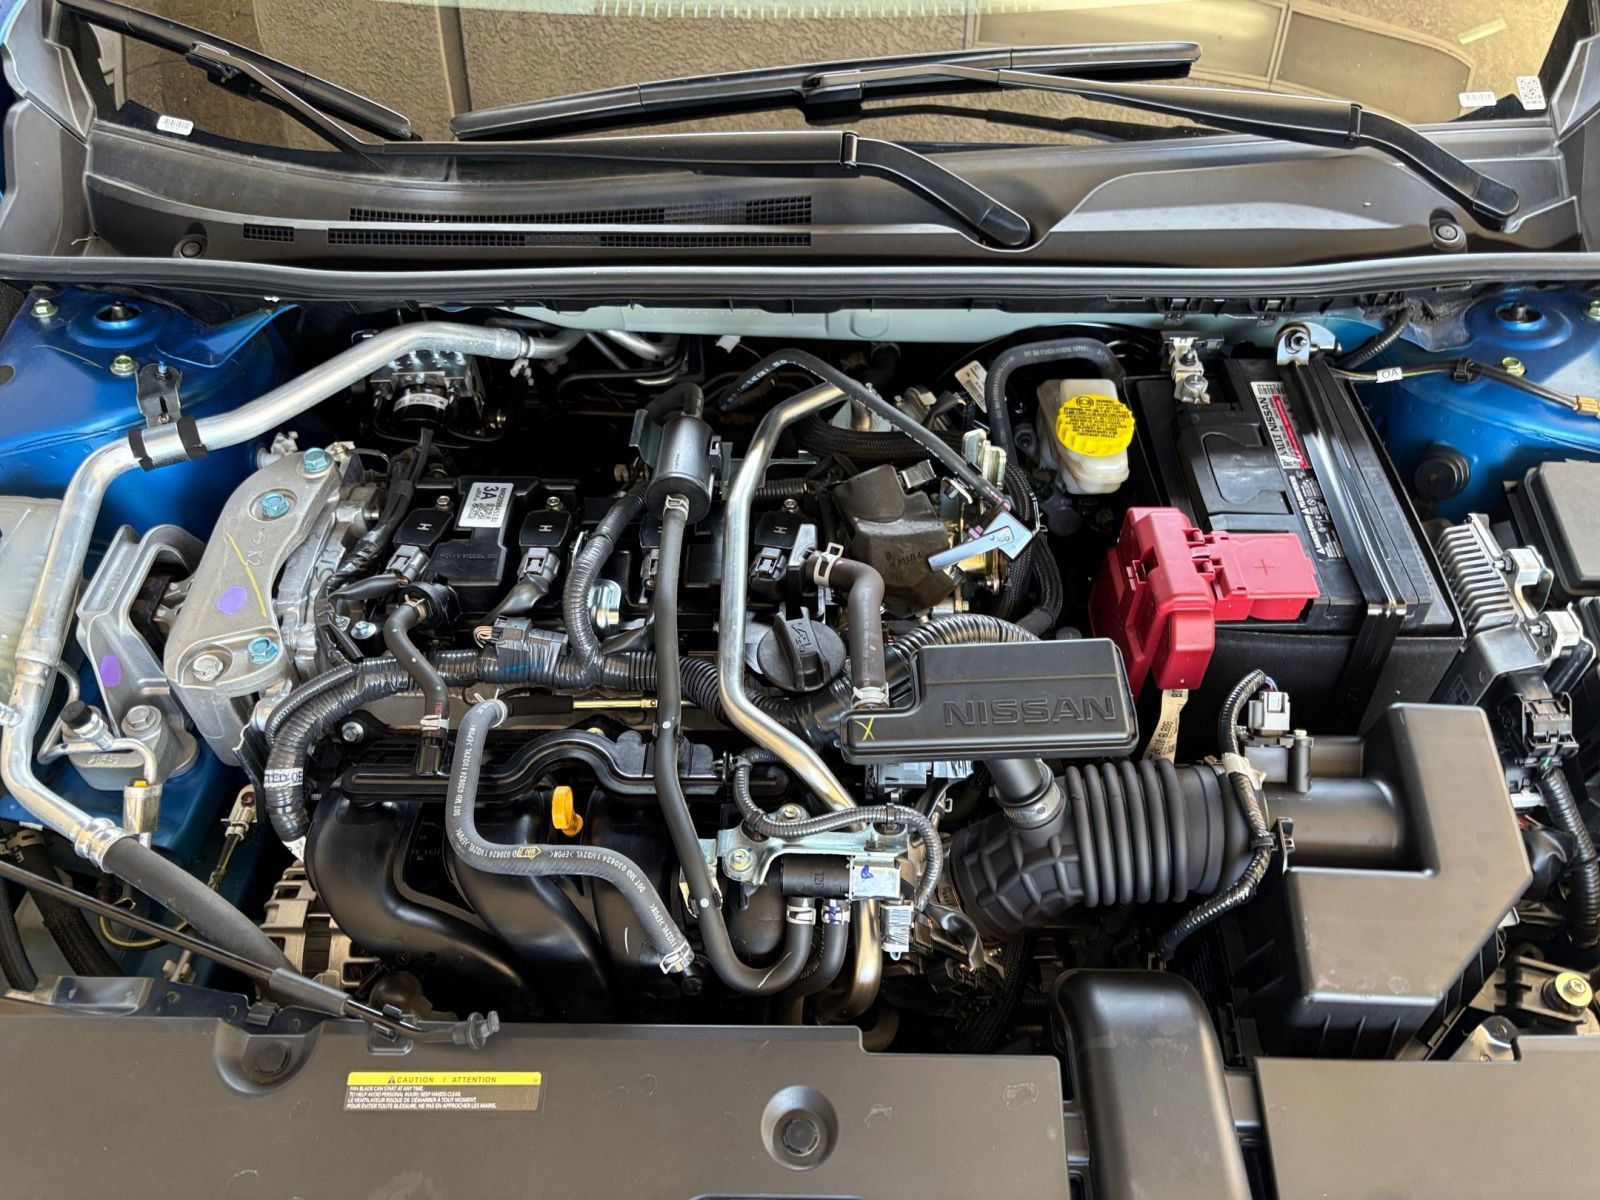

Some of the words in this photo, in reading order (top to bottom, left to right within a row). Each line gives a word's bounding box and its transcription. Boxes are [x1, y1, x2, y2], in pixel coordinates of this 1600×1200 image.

[1258, 397, 1279, 432] NISSAN
[1271, 434, 1293, 467] RNAULT
[481, 486, 500, 500] 3A
[943, 696, 1116, 726] NISSAN
[602, 855, 627, 872] 030624
[634, 880, 646, 893] DOT
[397, 1076, 435, 1084] CAUTION
